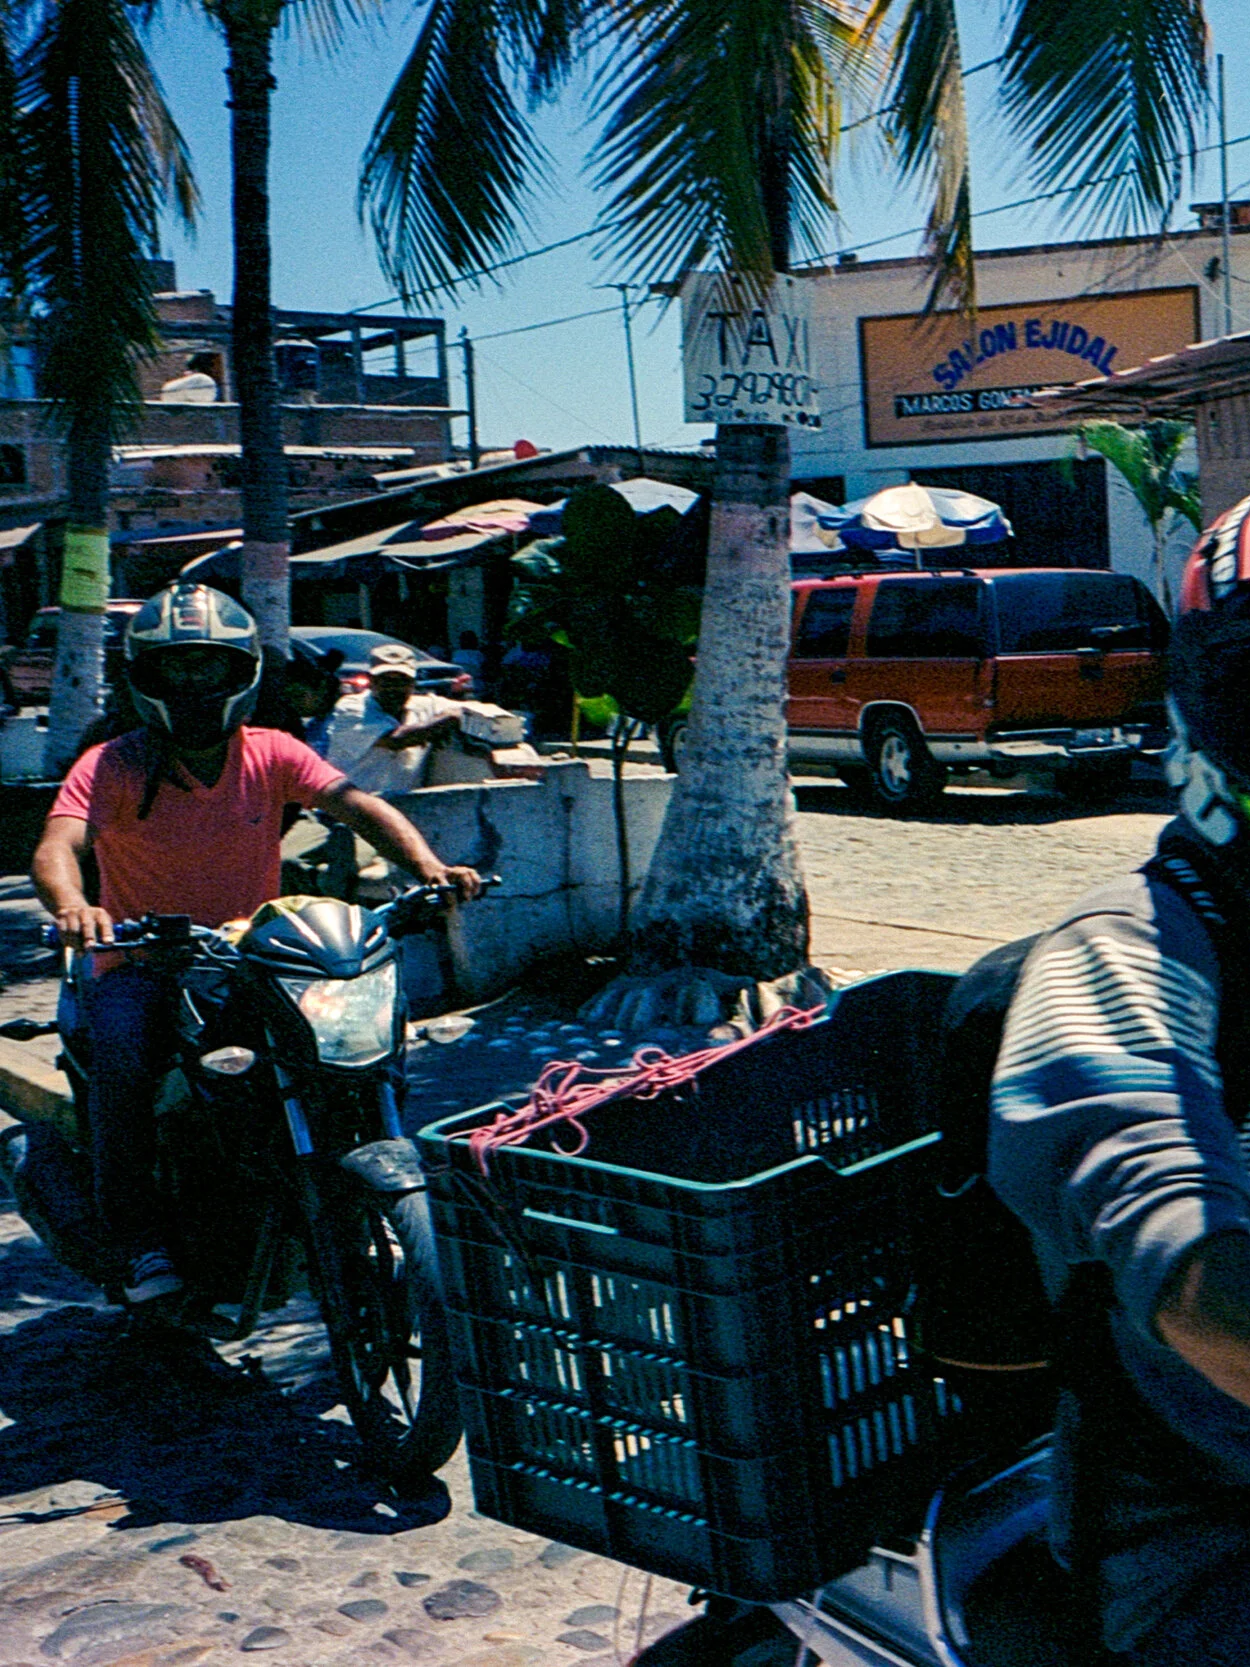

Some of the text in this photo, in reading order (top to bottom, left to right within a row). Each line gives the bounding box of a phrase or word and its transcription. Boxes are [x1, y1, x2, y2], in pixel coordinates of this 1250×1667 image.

[705, 309, 810, 371] TAXI
[932, 318, 1119, 390] SALON EJIDAL
[902, 392, 974, 416] MARCOS
